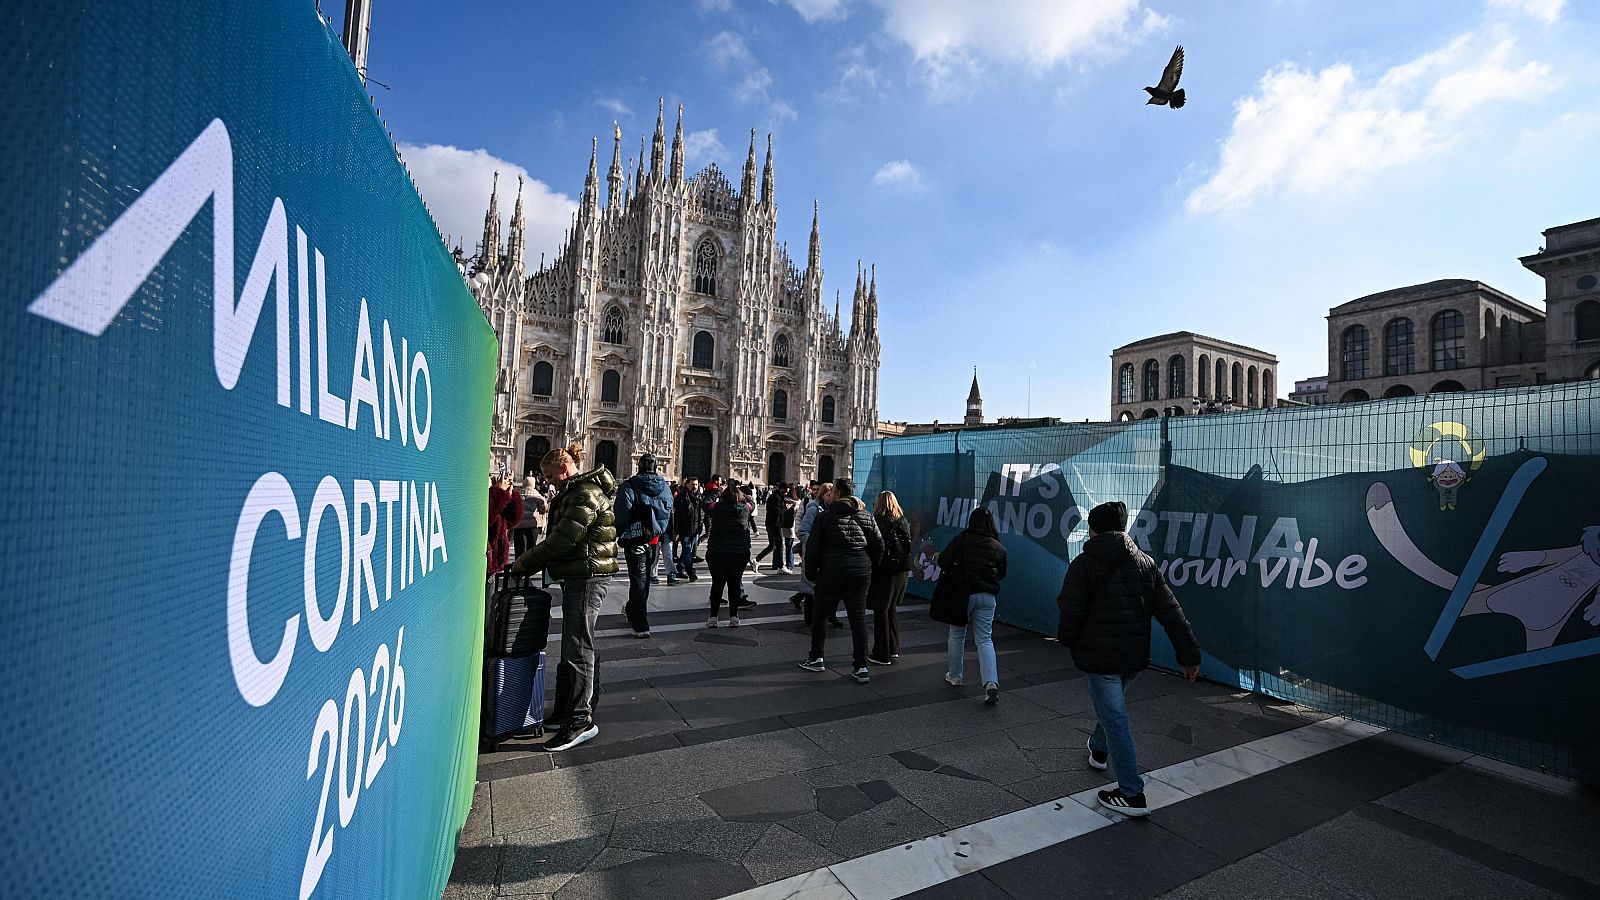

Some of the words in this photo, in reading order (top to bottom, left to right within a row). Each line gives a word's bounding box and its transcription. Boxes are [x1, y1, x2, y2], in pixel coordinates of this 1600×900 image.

[28, 117, 432, 451] MILANO
[998, 462, 1062, 499] IT'S
[1060, 506, 1304, 569] CRTINA
[227, 471, 448, 708] CORTINA
[1260, 537, 1368, 589] vibe
[299, 626, 405, 900] 2026
